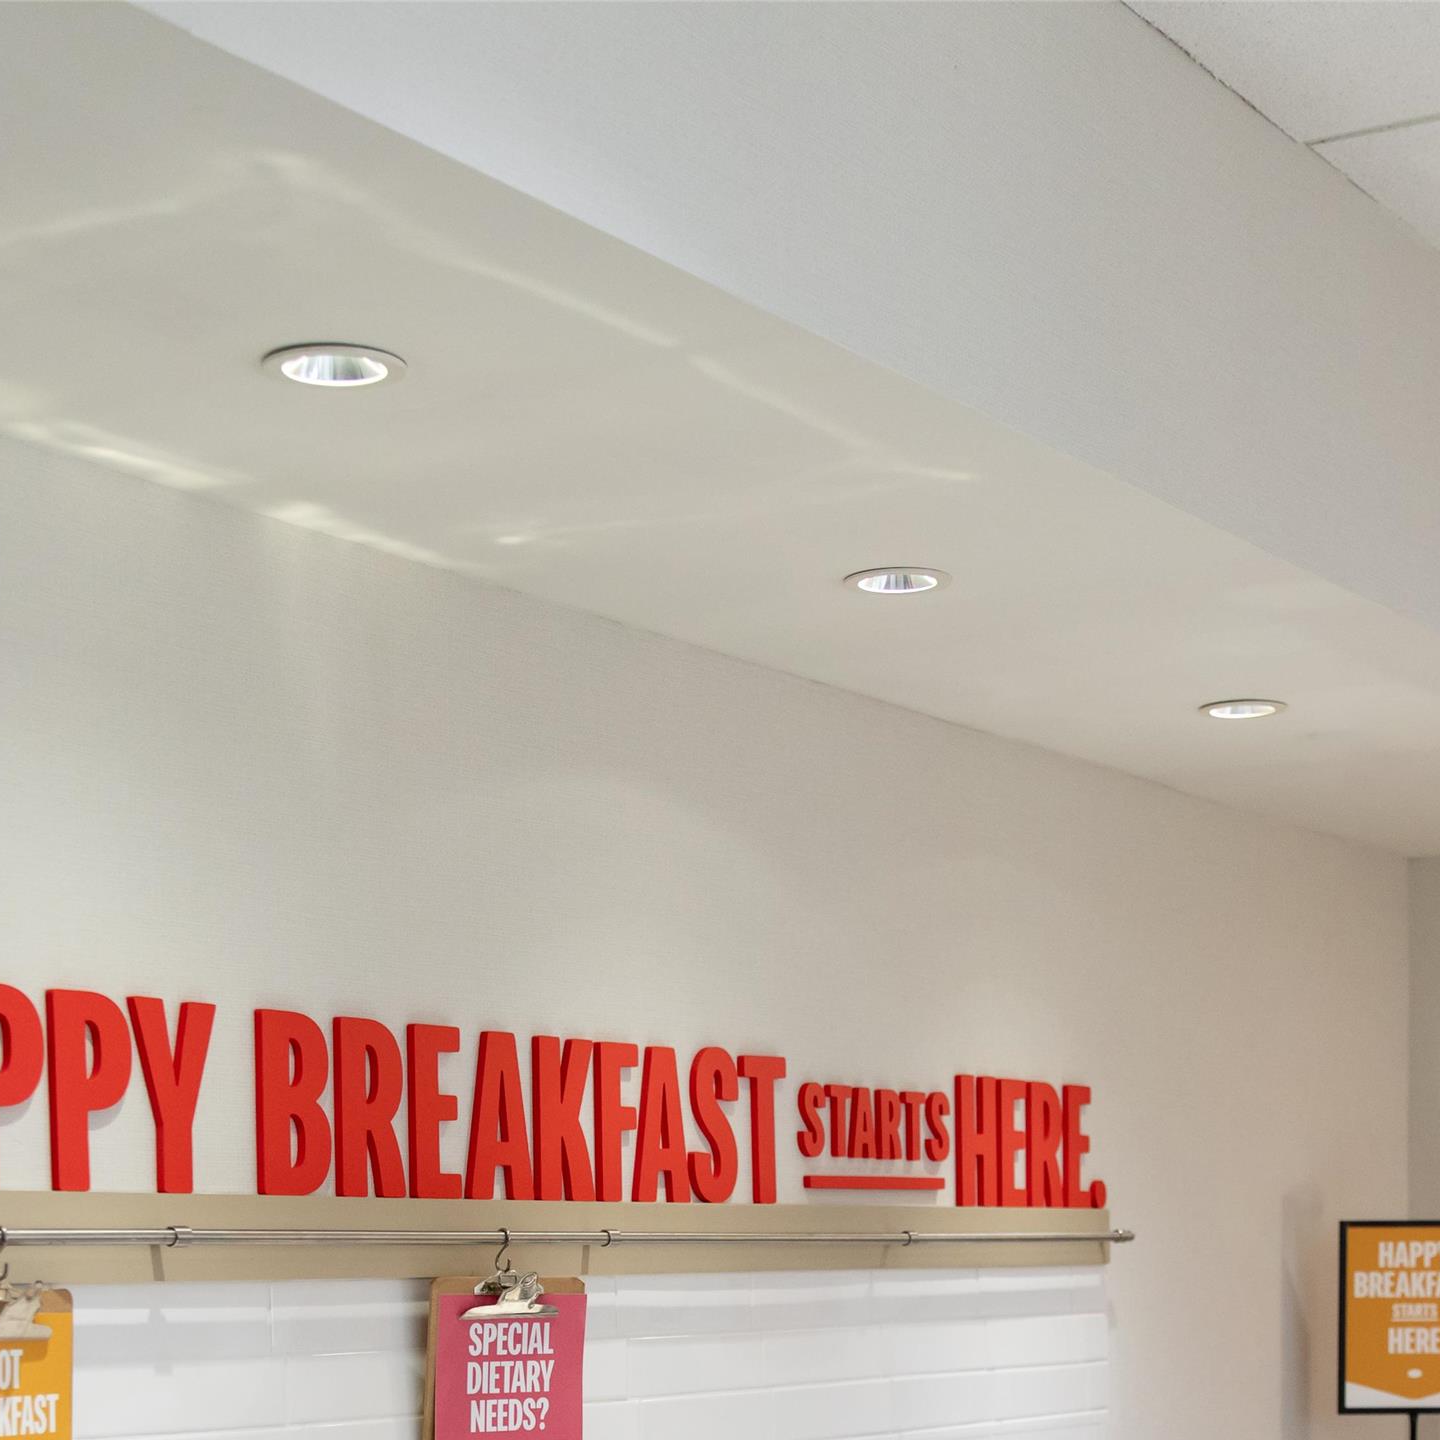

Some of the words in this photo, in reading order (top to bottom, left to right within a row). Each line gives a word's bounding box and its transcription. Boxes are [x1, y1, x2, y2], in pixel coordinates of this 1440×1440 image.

[254, 1008, 787, 1205] BREAKFAST
[796, 1081, 950, 1162] STARTS
[954, 1073, 1107, 1209] HERE.
[1391, 1302, 1439, 1321] STARTS
[468, 1321, 554, 1357] SPECIAL
[466, 1359, 555, 1395] DIETARY
[470, 1396, 550, 1434] NEEDS?
